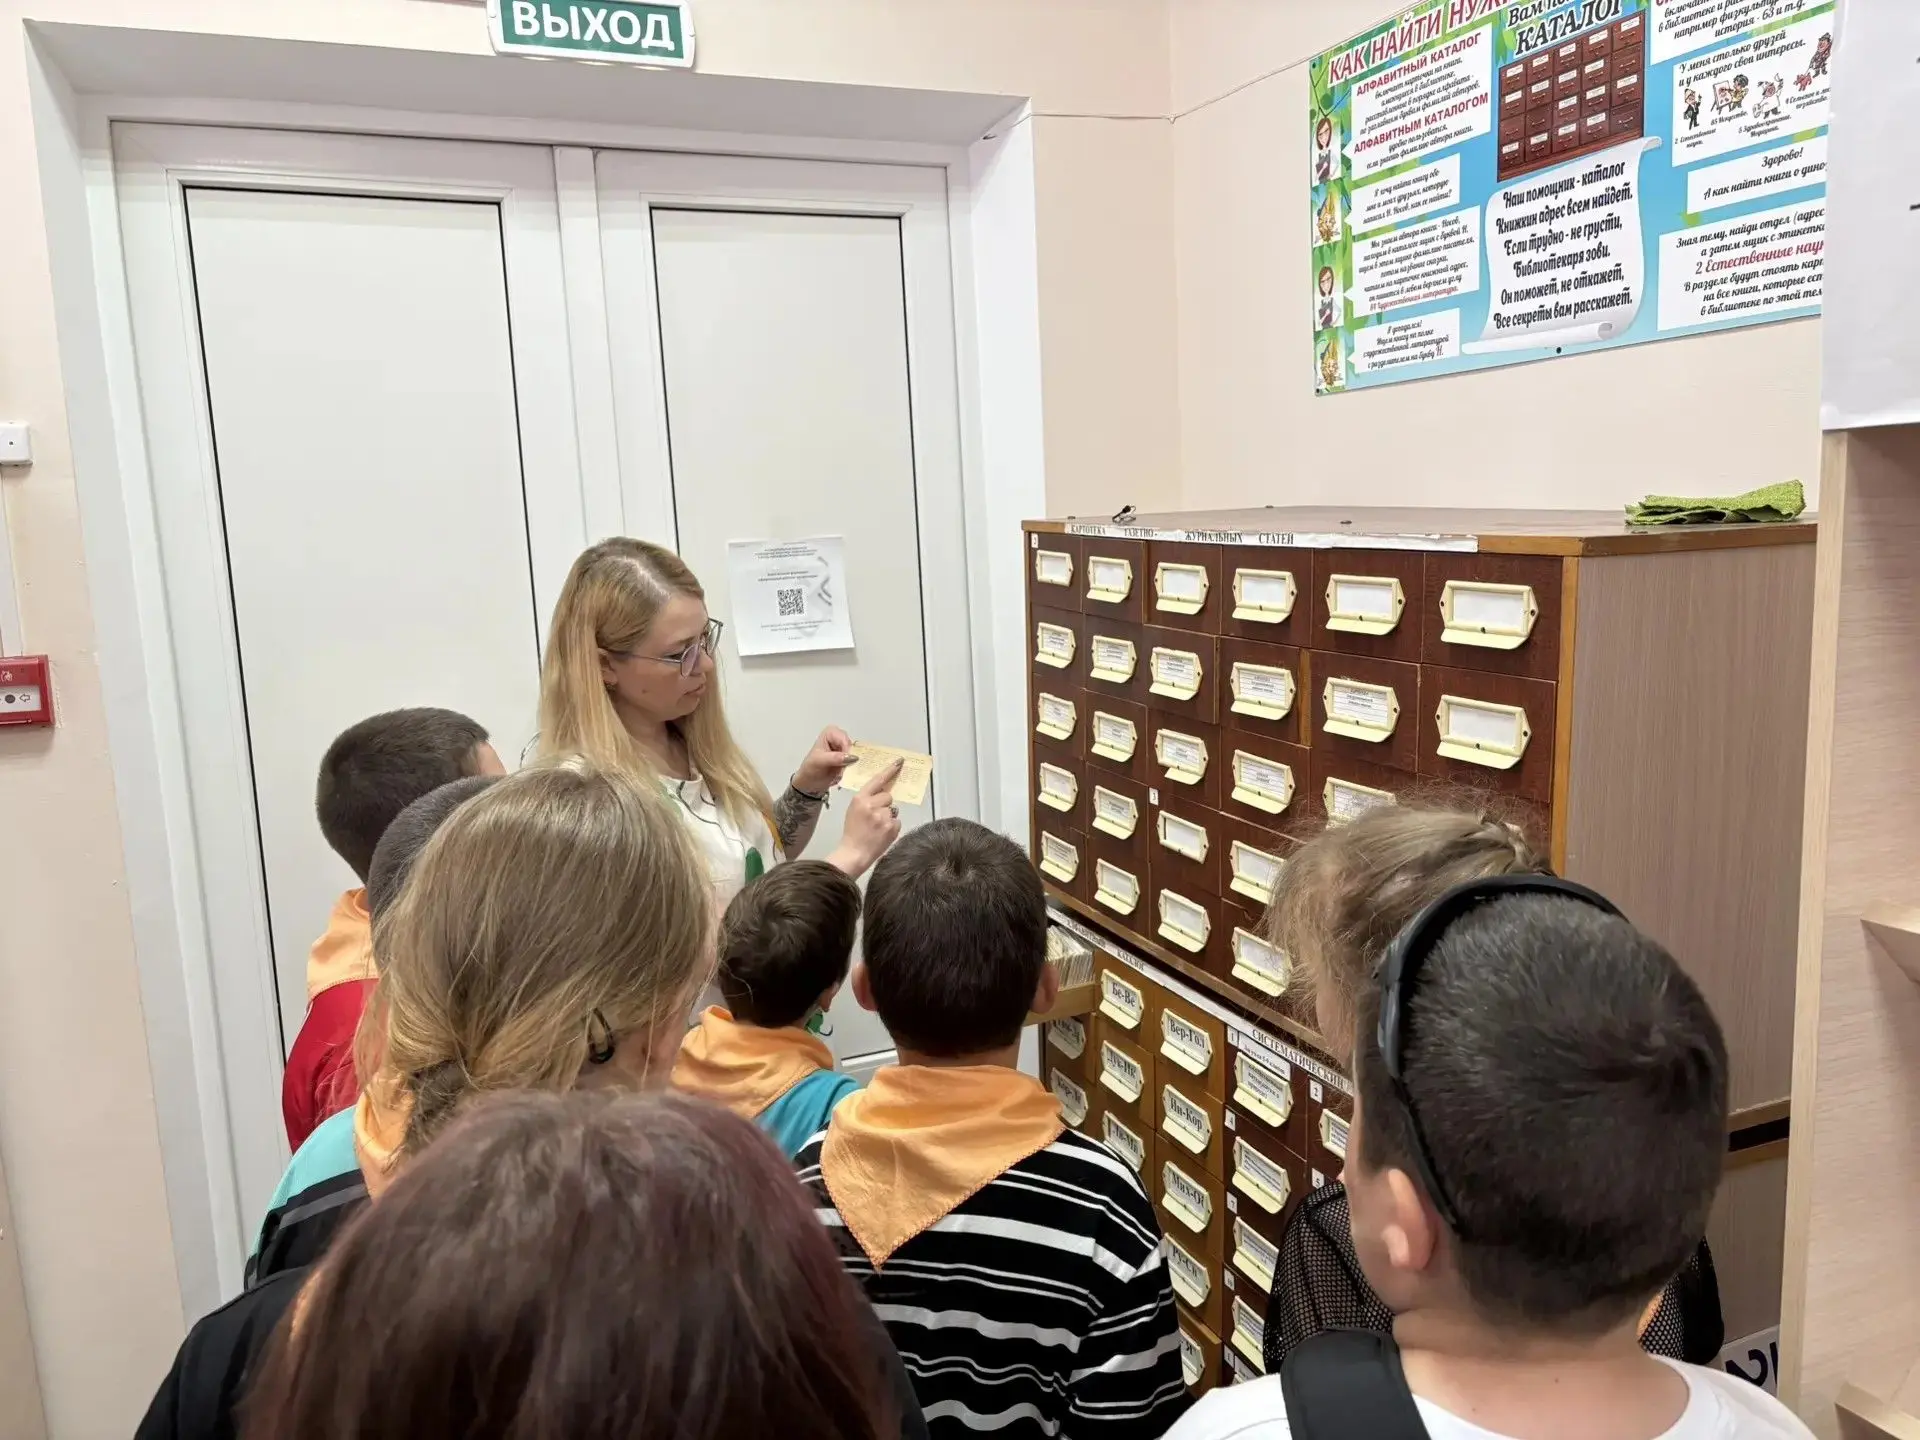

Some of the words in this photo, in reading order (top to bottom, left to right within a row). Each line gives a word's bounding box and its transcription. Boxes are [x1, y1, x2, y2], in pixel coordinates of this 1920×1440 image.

[512, 1, 675, 51] ВЫХОД
[1508, 1, 1543, 27] Вам
[1674, 17, 1718, 39] например
[1715, 16, 1755, 37] история
[1762, 6, 1775, 20] 63
[1330, 45, 1365, 84] КАК
[1371, 8, 1442, 65] НАЙТИ
[1688, 57, 1711, 72] меня
[1713, 42, 1751, 63] столько
[1753, 30, 1786, 52] друзей
[1357, 55, 1428, 96] АЛФАВИТНЫЙ
[1430, 32, 1482, 64] КАТАЛОГ
[1694, 63, 1732, 82] каждого
[1354, 120, 1421, 154] АЛФАВИТНЫМ
[1424, 92, 1489, 126] КАТАЛОГОМ
[1762, 147, 1804, 168] Здорово!
[1503, 191, 1525, 209] Наш
[1526, 176, 1576, 201] помощник
[1582, 162, 1626, 187] каталог
[1712, 185, 1729, 197] как
[1731, 177, 1762, 192] найти
[1764, 170, 1792, 184] книги
[1801, 162, 1827, 177] дино
[1496, 213, 1537, 236] Книжкин
[1539, 205, 1565, 226] адрес
[1567, 198, 1590, 216] всем
[1592, 181, 1633, 209] найдет.
[1504, 239, 1527, 257] Если
[1529, 230, 1564, 253] трудно
[1570, 226, 1582, 240] не
[1584, 213, 1622, 240] грусти,
[1676, 236, 1698, 248] Зная
[1729, 222, 1758, 235] найди
[1760, 215, 1790, 229] отдел
[1709, 242, 1741, 257] затем
[1742, 235, 1769, 248] ящик
[1513, 250, 1584, 278] Библиотекаря
[1586, 241, 1611, 262] зови.
[1695, 261, 1703, 275] 2
[1705, 247, 1793, 273] Естественные
[1501, 288, 1512, 305] Он
[1513, 277, 1560, 303] поможет,
[1561, 279, 1572, 293] не
[1574, 263, 1625, 290] откажет,
[1692, 276, 1729, 293] разделе
[1730, 270, 1759, 284] будут
[1761, 263, 1800, 277] стоять
[1703, 293, 1715, 302] на
[1716, 289, 1730, 298] все
[1762, 276, 1805, 290] которые
[1493, 313, 1511, 329] Все
[1512, 303, 1552, 328] секреты
[1553, 301, 1572, 319] вам
[1573, 287, 1633, 319] расскажет.
[1707, 298, 1761, 315] библиотеке
[1763, 296, 1774, 305] по
[1775, 289, 1802, 303] этой
[1184, 531, 1243, 543] ЖУРНАЛЬНЫХ
[1258, 532, 1294, 544] СТАТЕЙ
[1112, 981, 1136, 1008] Бе-Ве
[1170, 1018, 1205, 1049] Вер-Гол
